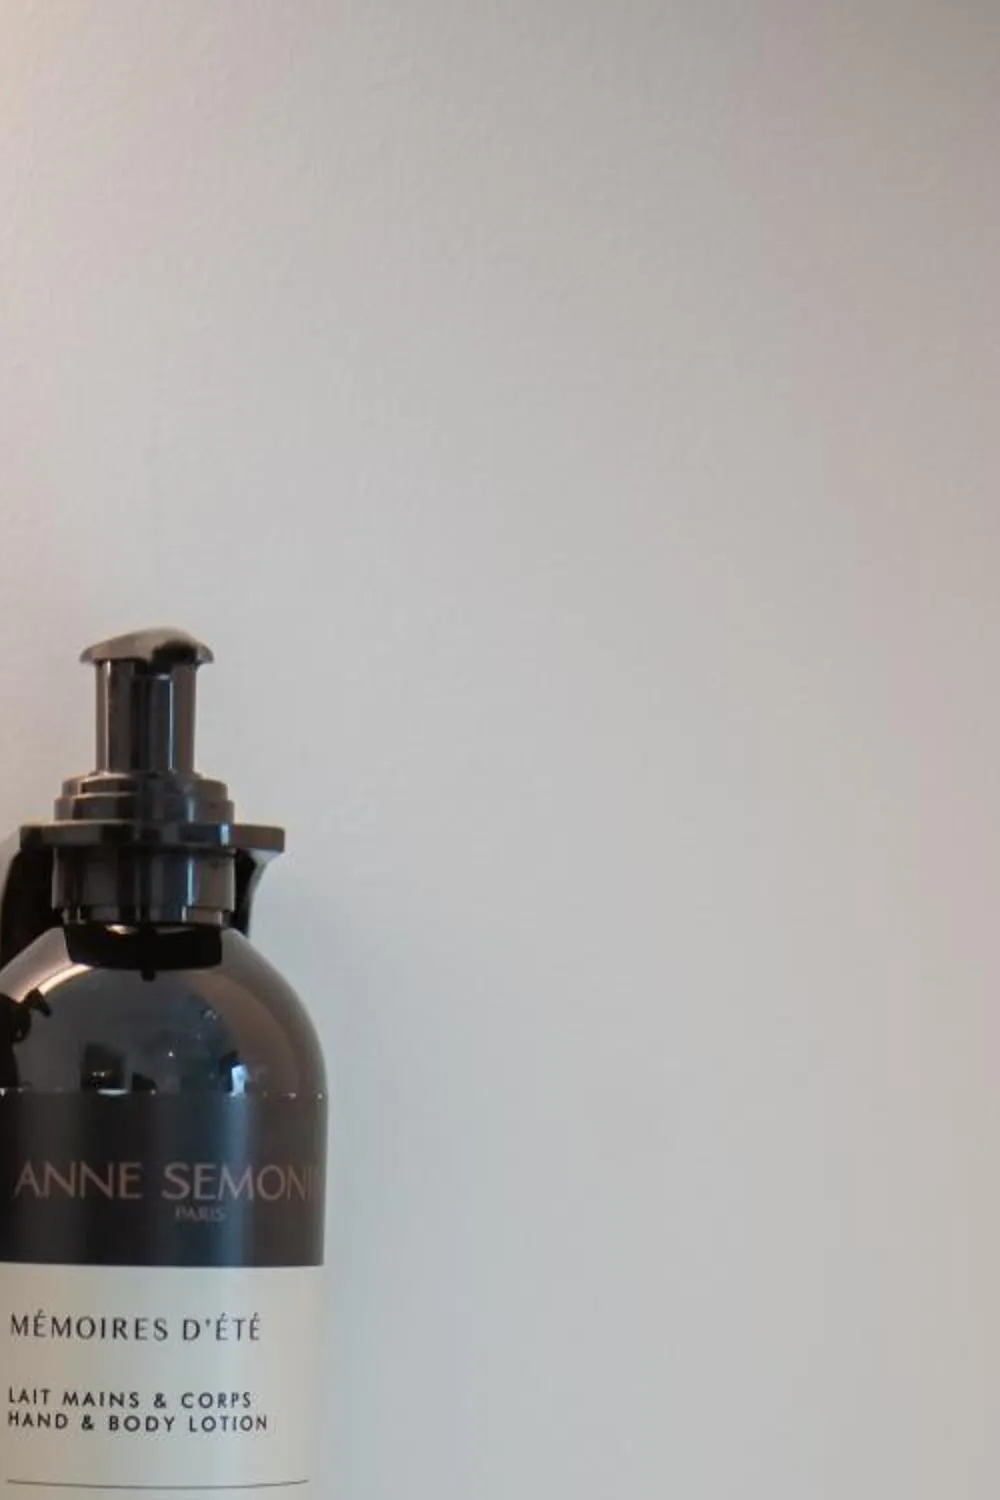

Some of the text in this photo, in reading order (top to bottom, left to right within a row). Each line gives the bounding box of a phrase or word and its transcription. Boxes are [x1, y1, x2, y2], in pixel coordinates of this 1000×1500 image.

[14, 1161, 142, 1198] ANNE
[175, 1205, 226, 1221] PARIS
[9, 1310, 168, 1341] MÉMOIRES
[9, 1386, 251, 1408] LAIT MAINS & CORPS
[8, 1412, 267, 1432] HAND & BODY LOTION
